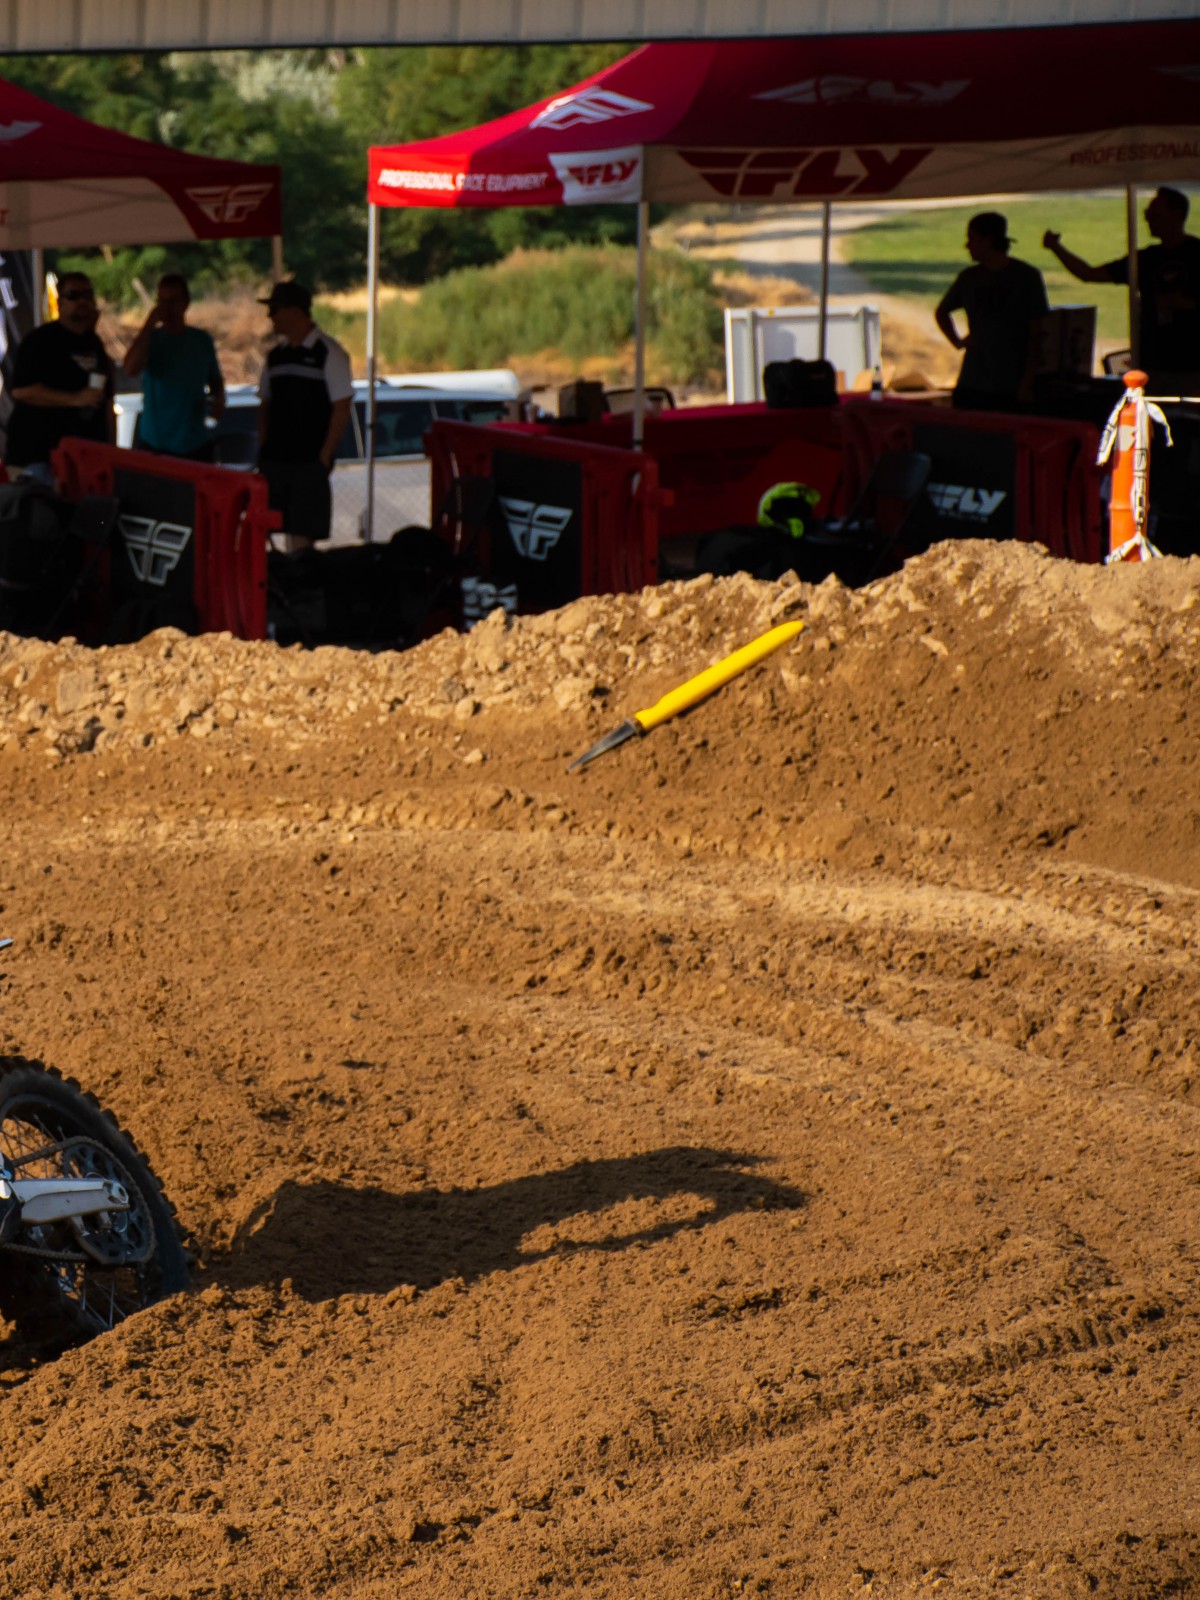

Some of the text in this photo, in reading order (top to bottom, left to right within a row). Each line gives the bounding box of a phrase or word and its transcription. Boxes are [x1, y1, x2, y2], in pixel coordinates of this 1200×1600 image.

[377, 168, 550, 192] PROFESSIONAL RACE EQUIPMENT
[567, 159, 639, 186] FLY
[677, 148, 934, 197] FLY
[927, 483, 1007, 515] FLY
